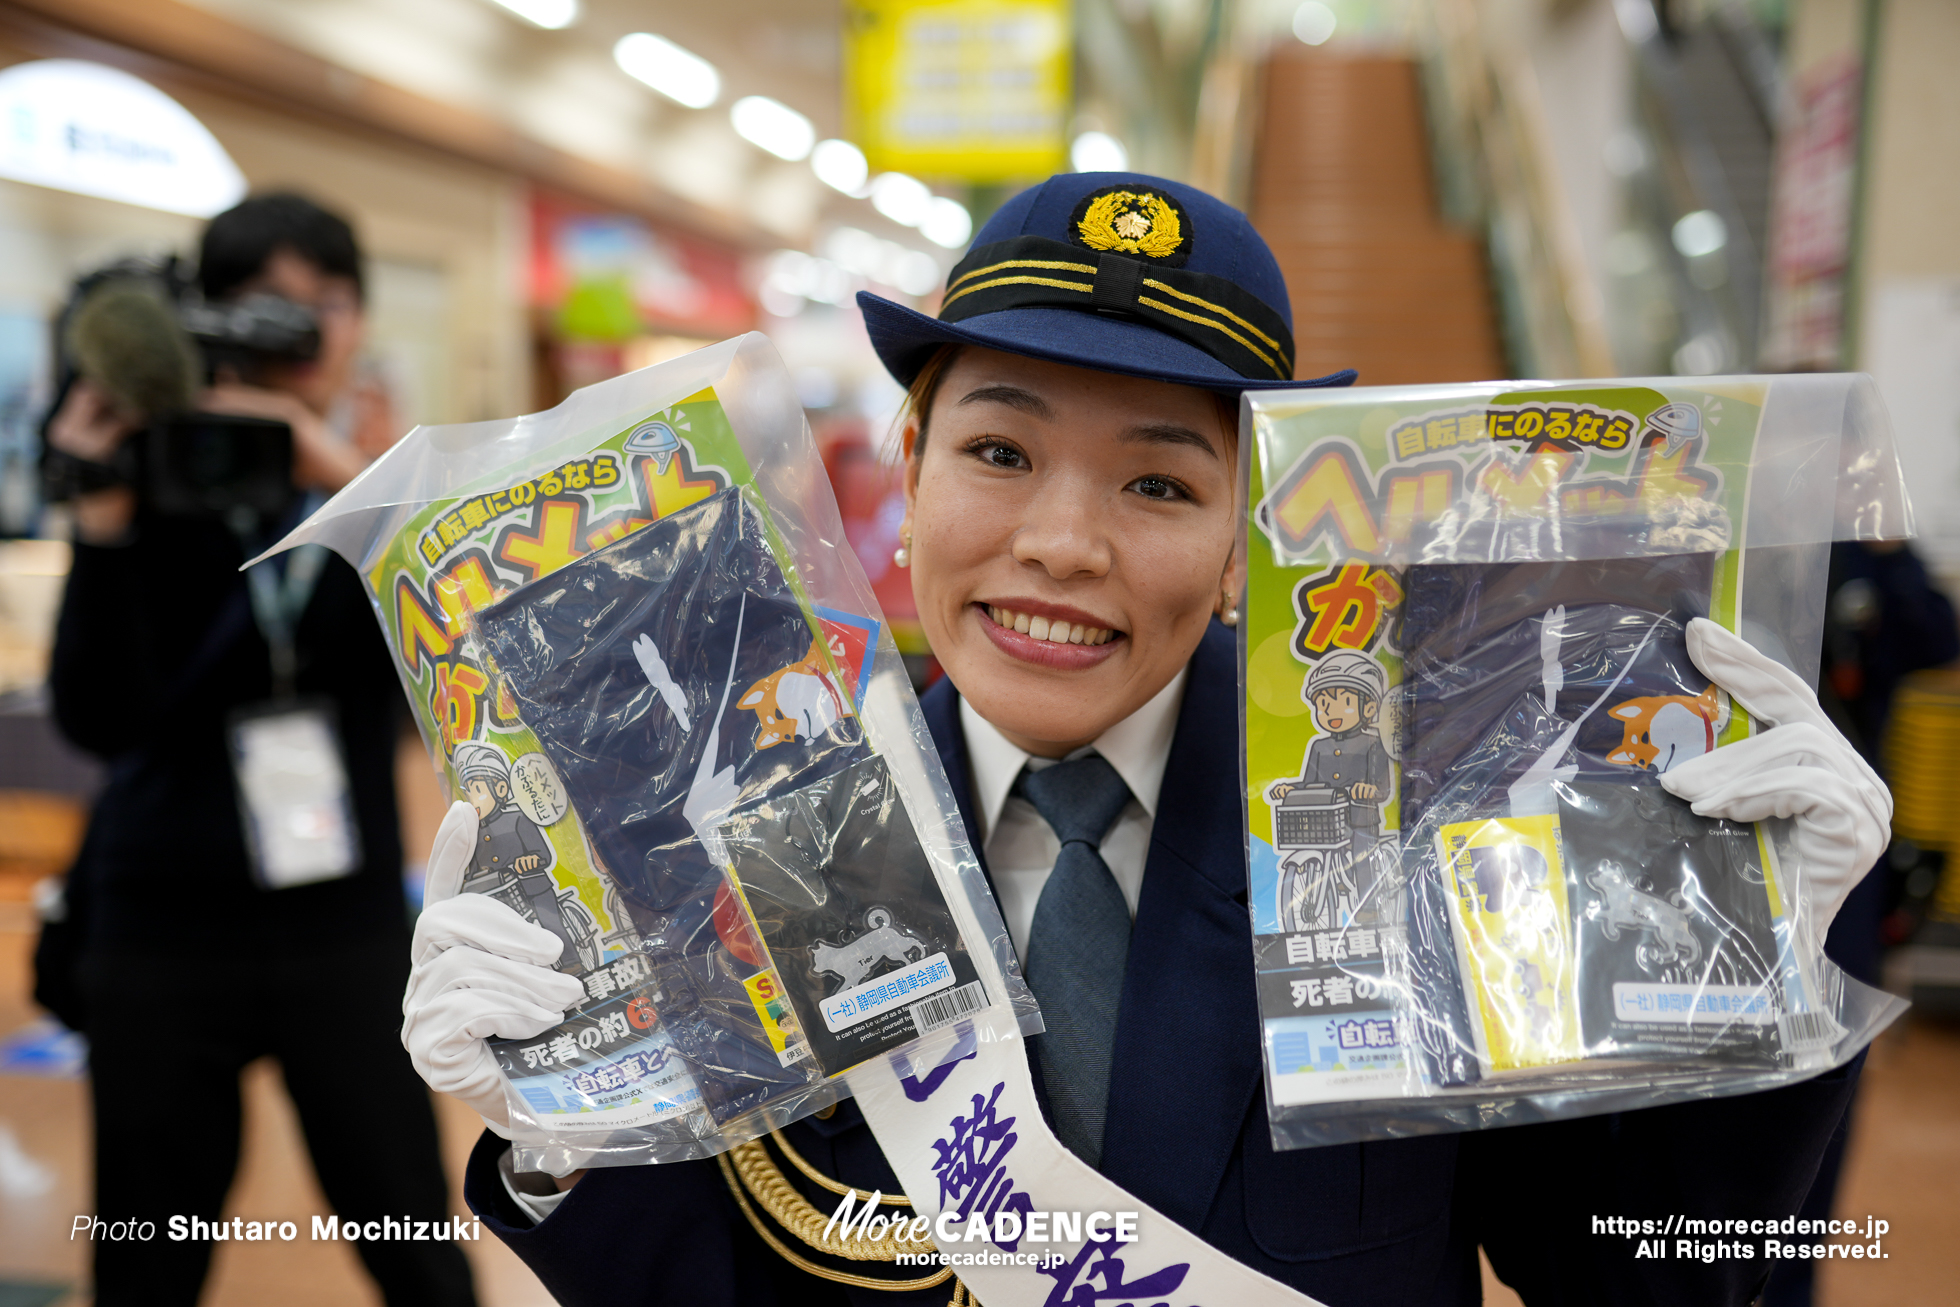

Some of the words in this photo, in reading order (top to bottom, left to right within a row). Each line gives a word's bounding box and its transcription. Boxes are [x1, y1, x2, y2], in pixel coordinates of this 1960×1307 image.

[1397, 412, 1629, 459] 自転車にのるなら
[420, 458, 617, 564] 自転車にのるなら
[515, 765, 550, 821] かぶるだに
[528, 758, 563, 815] ヘルメット
[860, 802, 881, 815] Crystal
[1569, 792, 1590, 803] Ter
[574, 954, 652, 1003] 事故
[858, 954, 873, 967] Tier
[874, 1015, 889, 1025] ued
